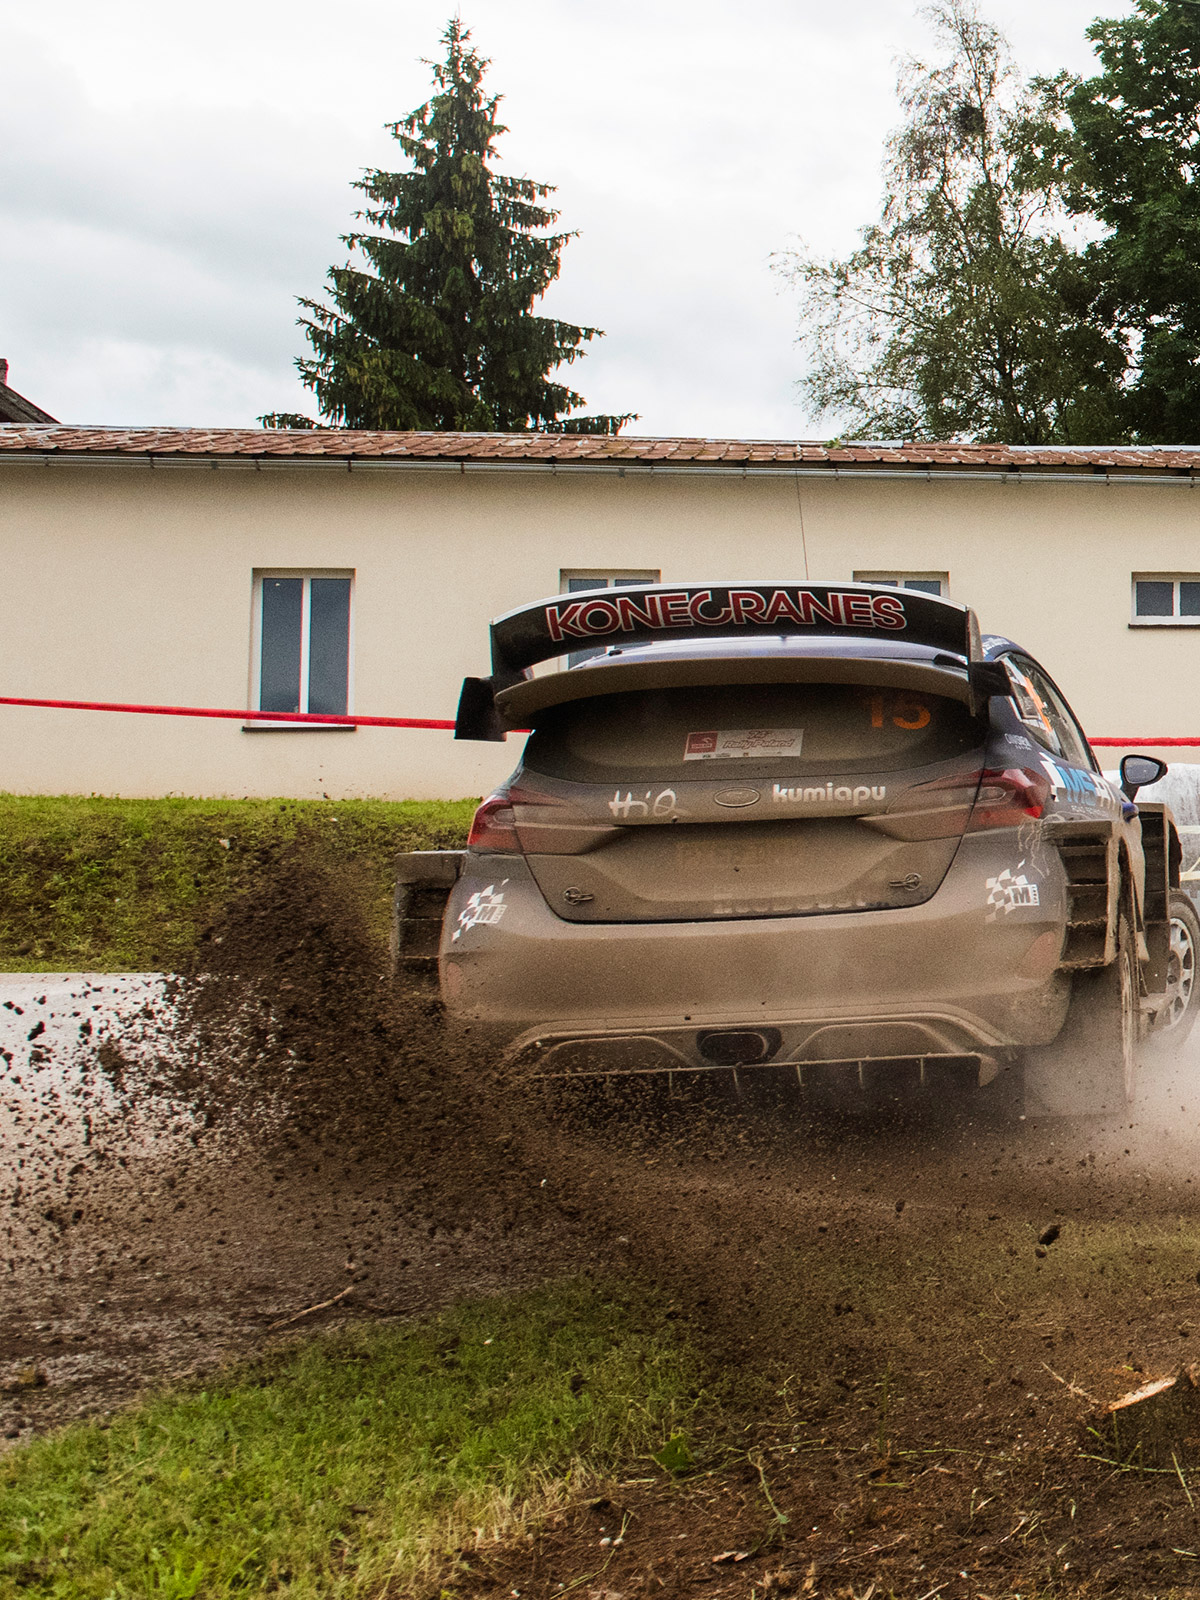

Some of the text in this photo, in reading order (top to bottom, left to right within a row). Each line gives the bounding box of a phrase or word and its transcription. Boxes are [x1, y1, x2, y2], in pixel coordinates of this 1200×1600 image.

[545, 589, 907, 642] KONECRANES
[864, 693, 932, 731] 15
[608, 787, 692, 818] HiQ
[772, 781, 886, 806] kumiapu
